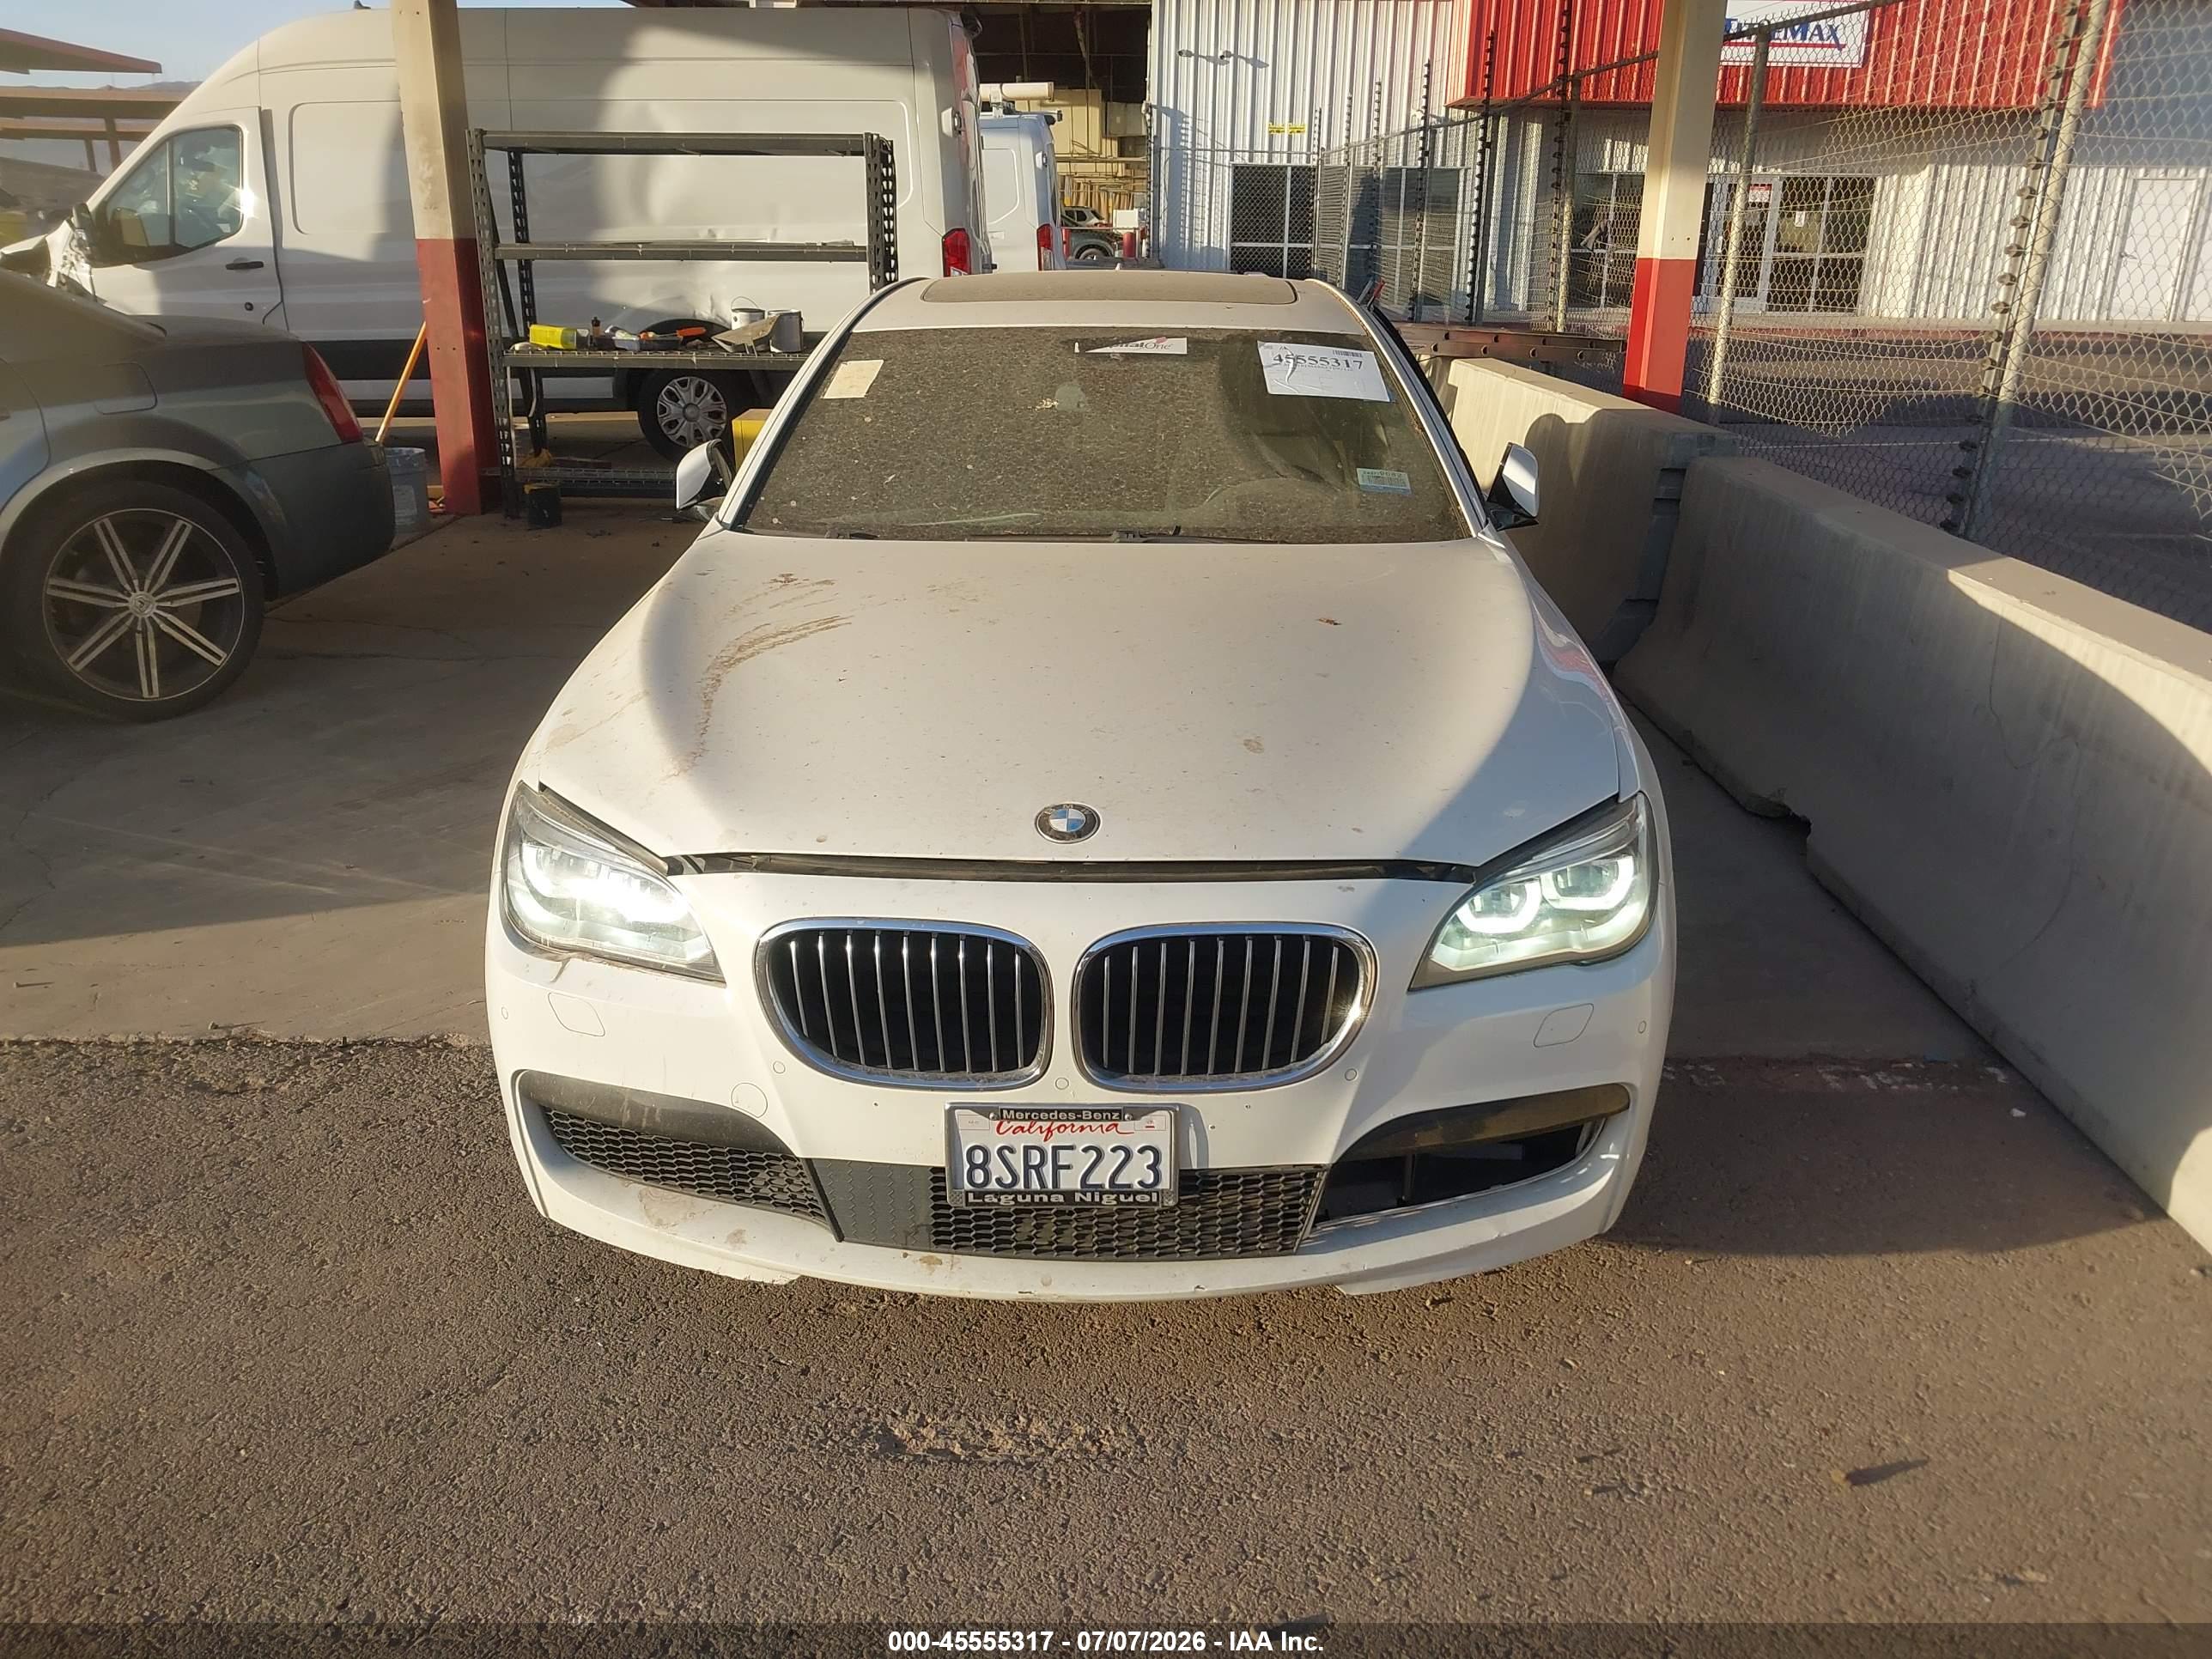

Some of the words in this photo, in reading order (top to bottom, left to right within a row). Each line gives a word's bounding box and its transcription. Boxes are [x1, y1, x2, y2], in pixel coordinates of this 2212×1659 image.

[1273, 352, 1364, 370] 45555317
[1002, 1109, 1121, 1121] Mercedes-Benz
[995, 1120, 1135, 1142] California
[965, 1144, 1164, 1189] 8SRF223
[967, 1192, 1065, 1204] Laguna
[1074, 1191, 1158, 1205] Niguel
